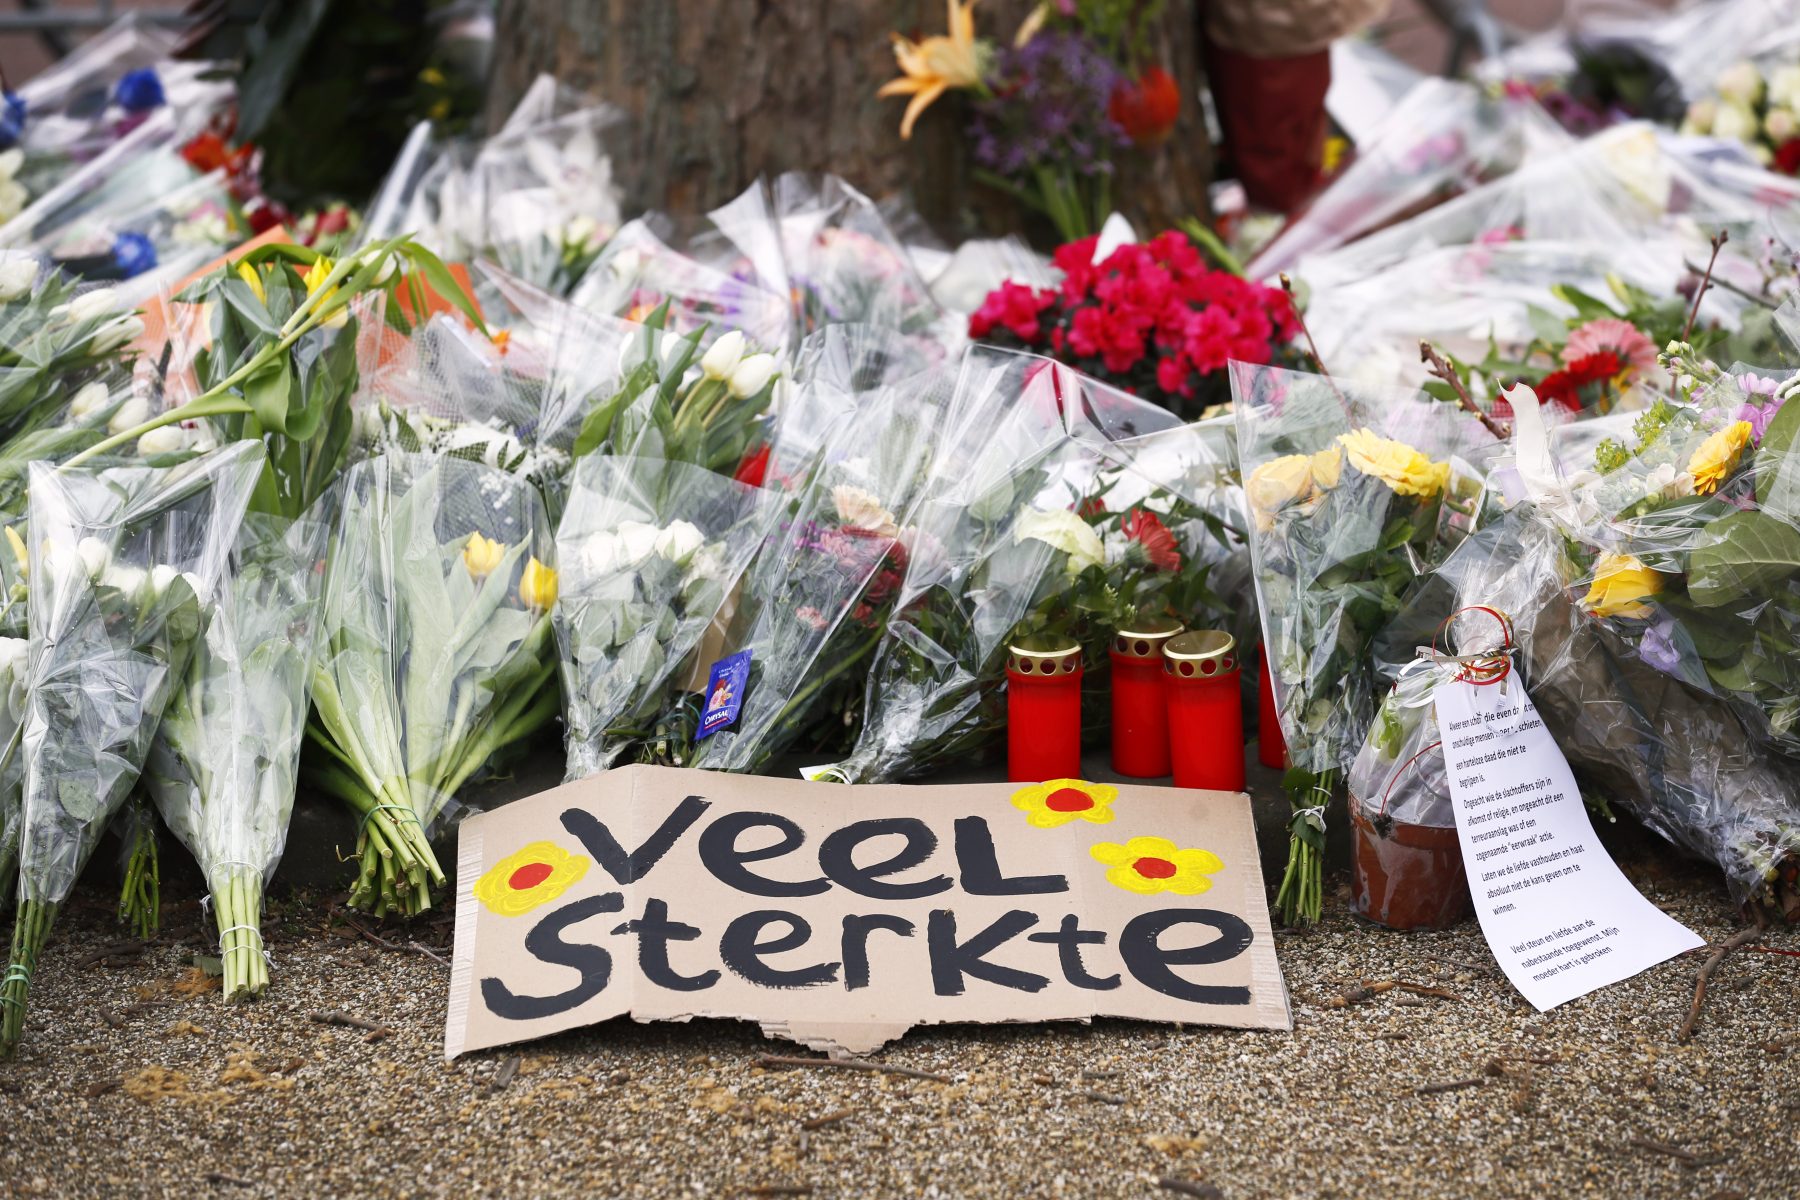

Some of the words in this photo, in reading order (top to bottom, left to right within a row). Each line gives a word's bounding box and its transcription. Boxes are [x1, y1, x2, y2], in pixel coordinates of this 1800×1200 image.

[1462, 718, 1471, 729] een
[1484, 711, 1495, 723] die
[1497, 709, 1512, 720] even
[1452, 735, 1475, 749] onschuldige
[1475, 732, 1495, 744] mensen
[1456, 761, 1464, 771] een
[1463, 754, 1484, 769] harteloze
[1484, 749, 1497, 763] daad
[1497, 748, 1506, 759] die
[1506, 745, 1519, 757] niet
[1519, 744, 1527, 754] te
[1458, 775, 1479, 790] begrijpen
[1463, 793, 1485, 810] Ongeacht
[1485, 791, 1495, 802] wie
[1495, 790, 1502, 800] de
[1503, 781, 1535, 799] slachtoffers
[1535, 778, 1545, 790] zijn
[1545, 776, 1552, 786] in
[1467, 812, 1486, 826] afkomst
[1486, 809, 1492, 821] of
[1493, 806, 1512, 819] religie,
[1511, 805, 1519, 814] en
[1519, 797, 1545, 813] ongeacht
[1544, 794, 1553, 804] dit
[1553, 792, 1565, 802] een
[1471, 826, 1508, 844] terreuraanslag
[1508, 823, 1519, 833] was
[1519, 819, 1526, 830] of
[1525, 818, 1537, 829] een
[1475, 843, 1508, 861] zogenaamde
[1539, 830, 1555, 843] actie.
[1481, 870, 1497, 882] Laten
[1497, 867, 1506, 877] we
[1506, 864, 1514, 874] de
[1513, 859, 1530, 873] liefde
[1530, 852, 1563, 868] vasthouden
[1562, 849, 1571, 858] en
[1570, 844, 1585, 856] haat
[1487, 884, 1512, 899] absoluut
[1511, 880, 1524, 892] niet
[1523, 878, 1531, 888] de
[1530, 874, 1546, 886] kans
[1545, 869, 1563, 883] geven
[1563, 866, 1574, 876] om
[1573, 863, 1581, 872] te
[1492, 903, 1517, 915] winnen.
[1510, 942, 1527, 954] Veel
[1526, 937, 1545, 950] steun
[1544, 933, 1555, 943] en
[1552, 927, 1574, 940] liefde
[1572, 922, 1587, 933] aan
[1584, 918, 1596, 927] de
[1521, 948, 1564, 969] nabestaande
[1561, 932, 1603, 952] toegewenst.
[1601, 926, 1620, 936] Mijn
[1532, 966, 1560, 982] moeder
[1557, 959, 1576, 972] hart
[1572, 957, 1582, 966] is
[1581, 945, 1613, 965] gebroken
